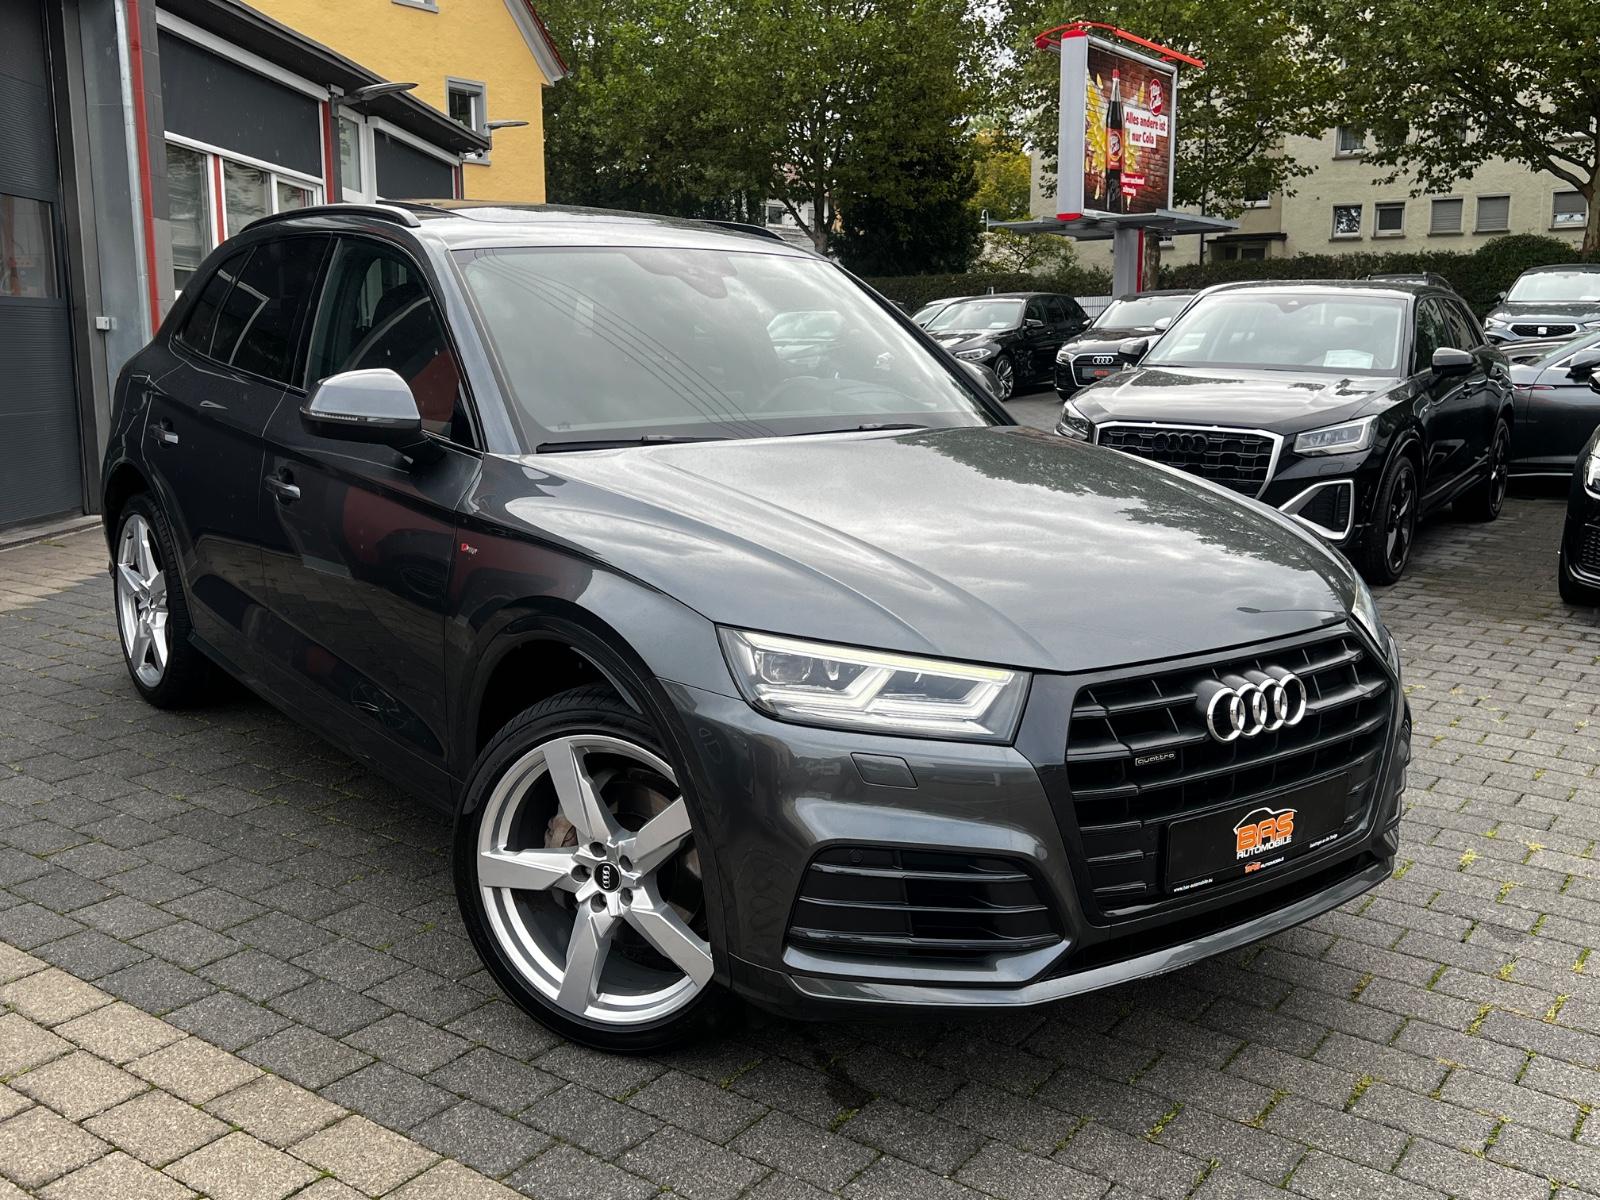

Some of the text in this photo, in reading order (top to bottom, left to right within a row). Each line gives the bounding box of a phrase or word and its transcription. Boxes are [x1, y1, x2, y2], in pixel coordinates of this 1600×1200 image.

[1126, 111, 1139, 126] Alles
[1140, 115, 1158, 130] andere
[1132, 131, 1155, 145] nur Cola
[1136, 752, 1175, 766] quattro
[1236, 811, 1295, 853] BAS
[1236, 835, 1293, 860] AUTOMOBILE
